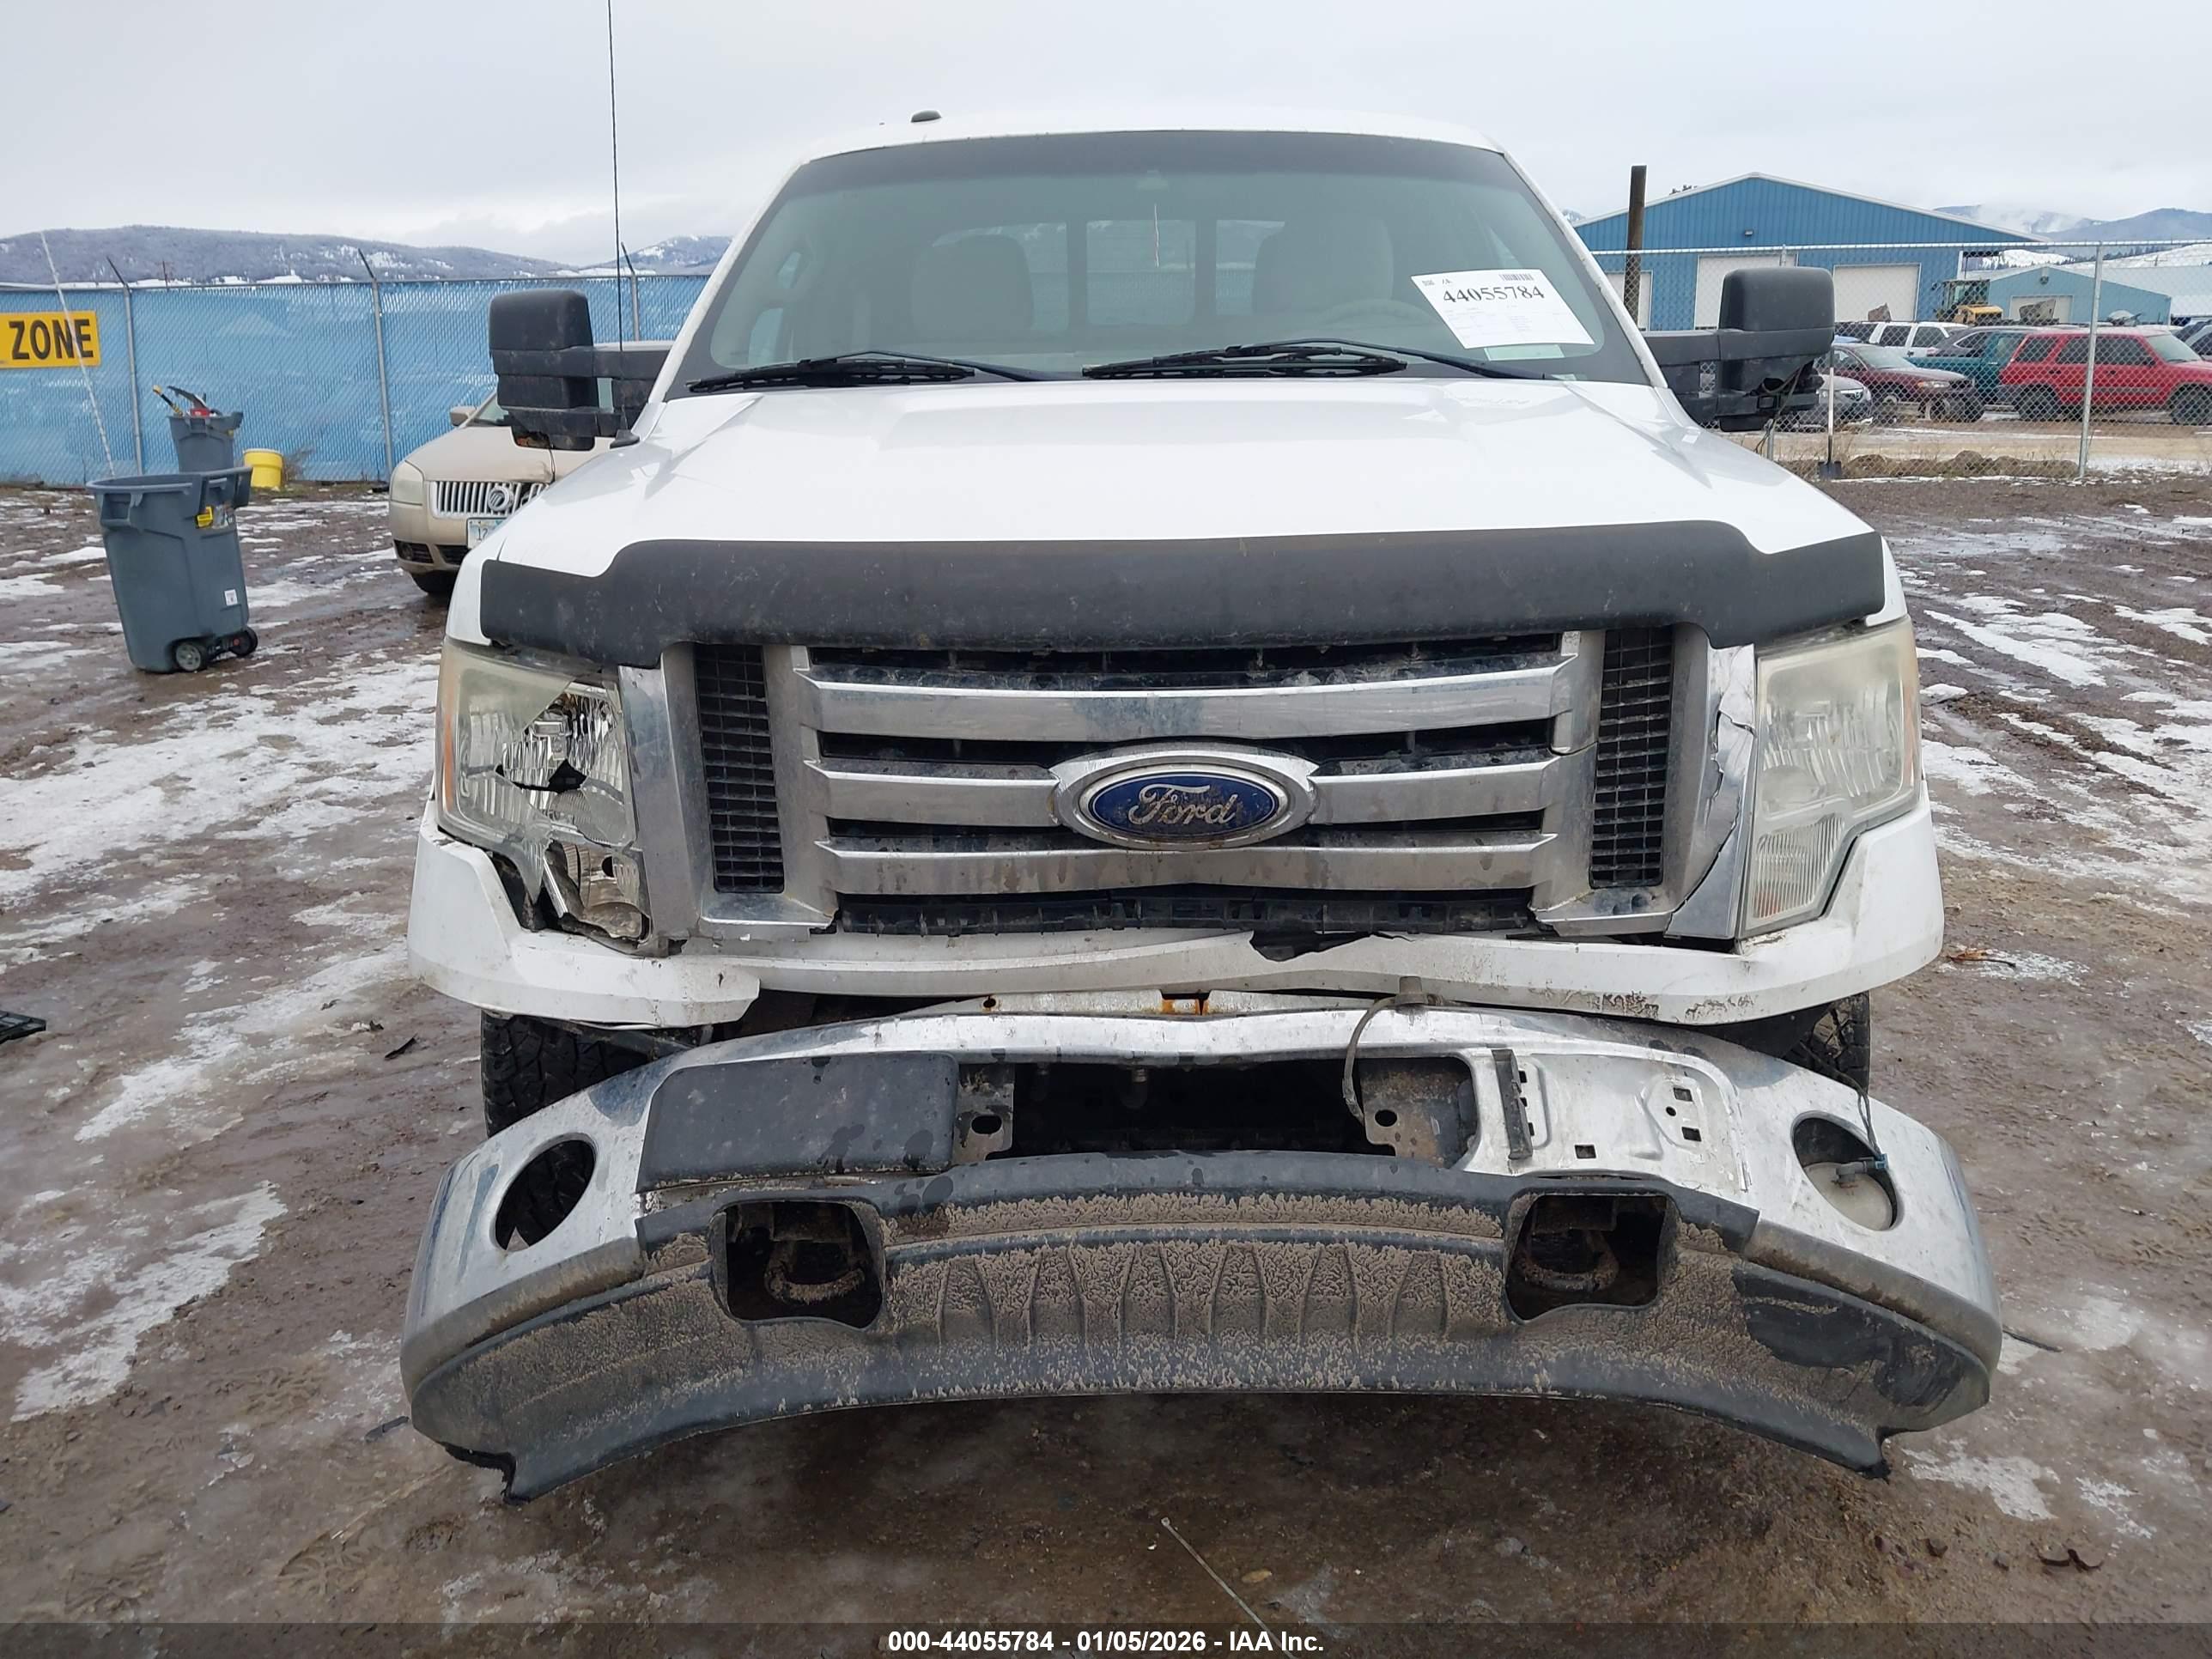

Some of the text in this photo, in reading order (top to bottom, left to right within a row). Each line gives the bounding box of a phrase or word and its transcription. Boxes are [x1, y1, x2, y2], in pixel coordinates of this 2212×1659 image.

[1443, 285, 1545, 302] 44055784
[9, 319, 94, 360] ZONE
[1128, 783, 1238, 825] Ford
